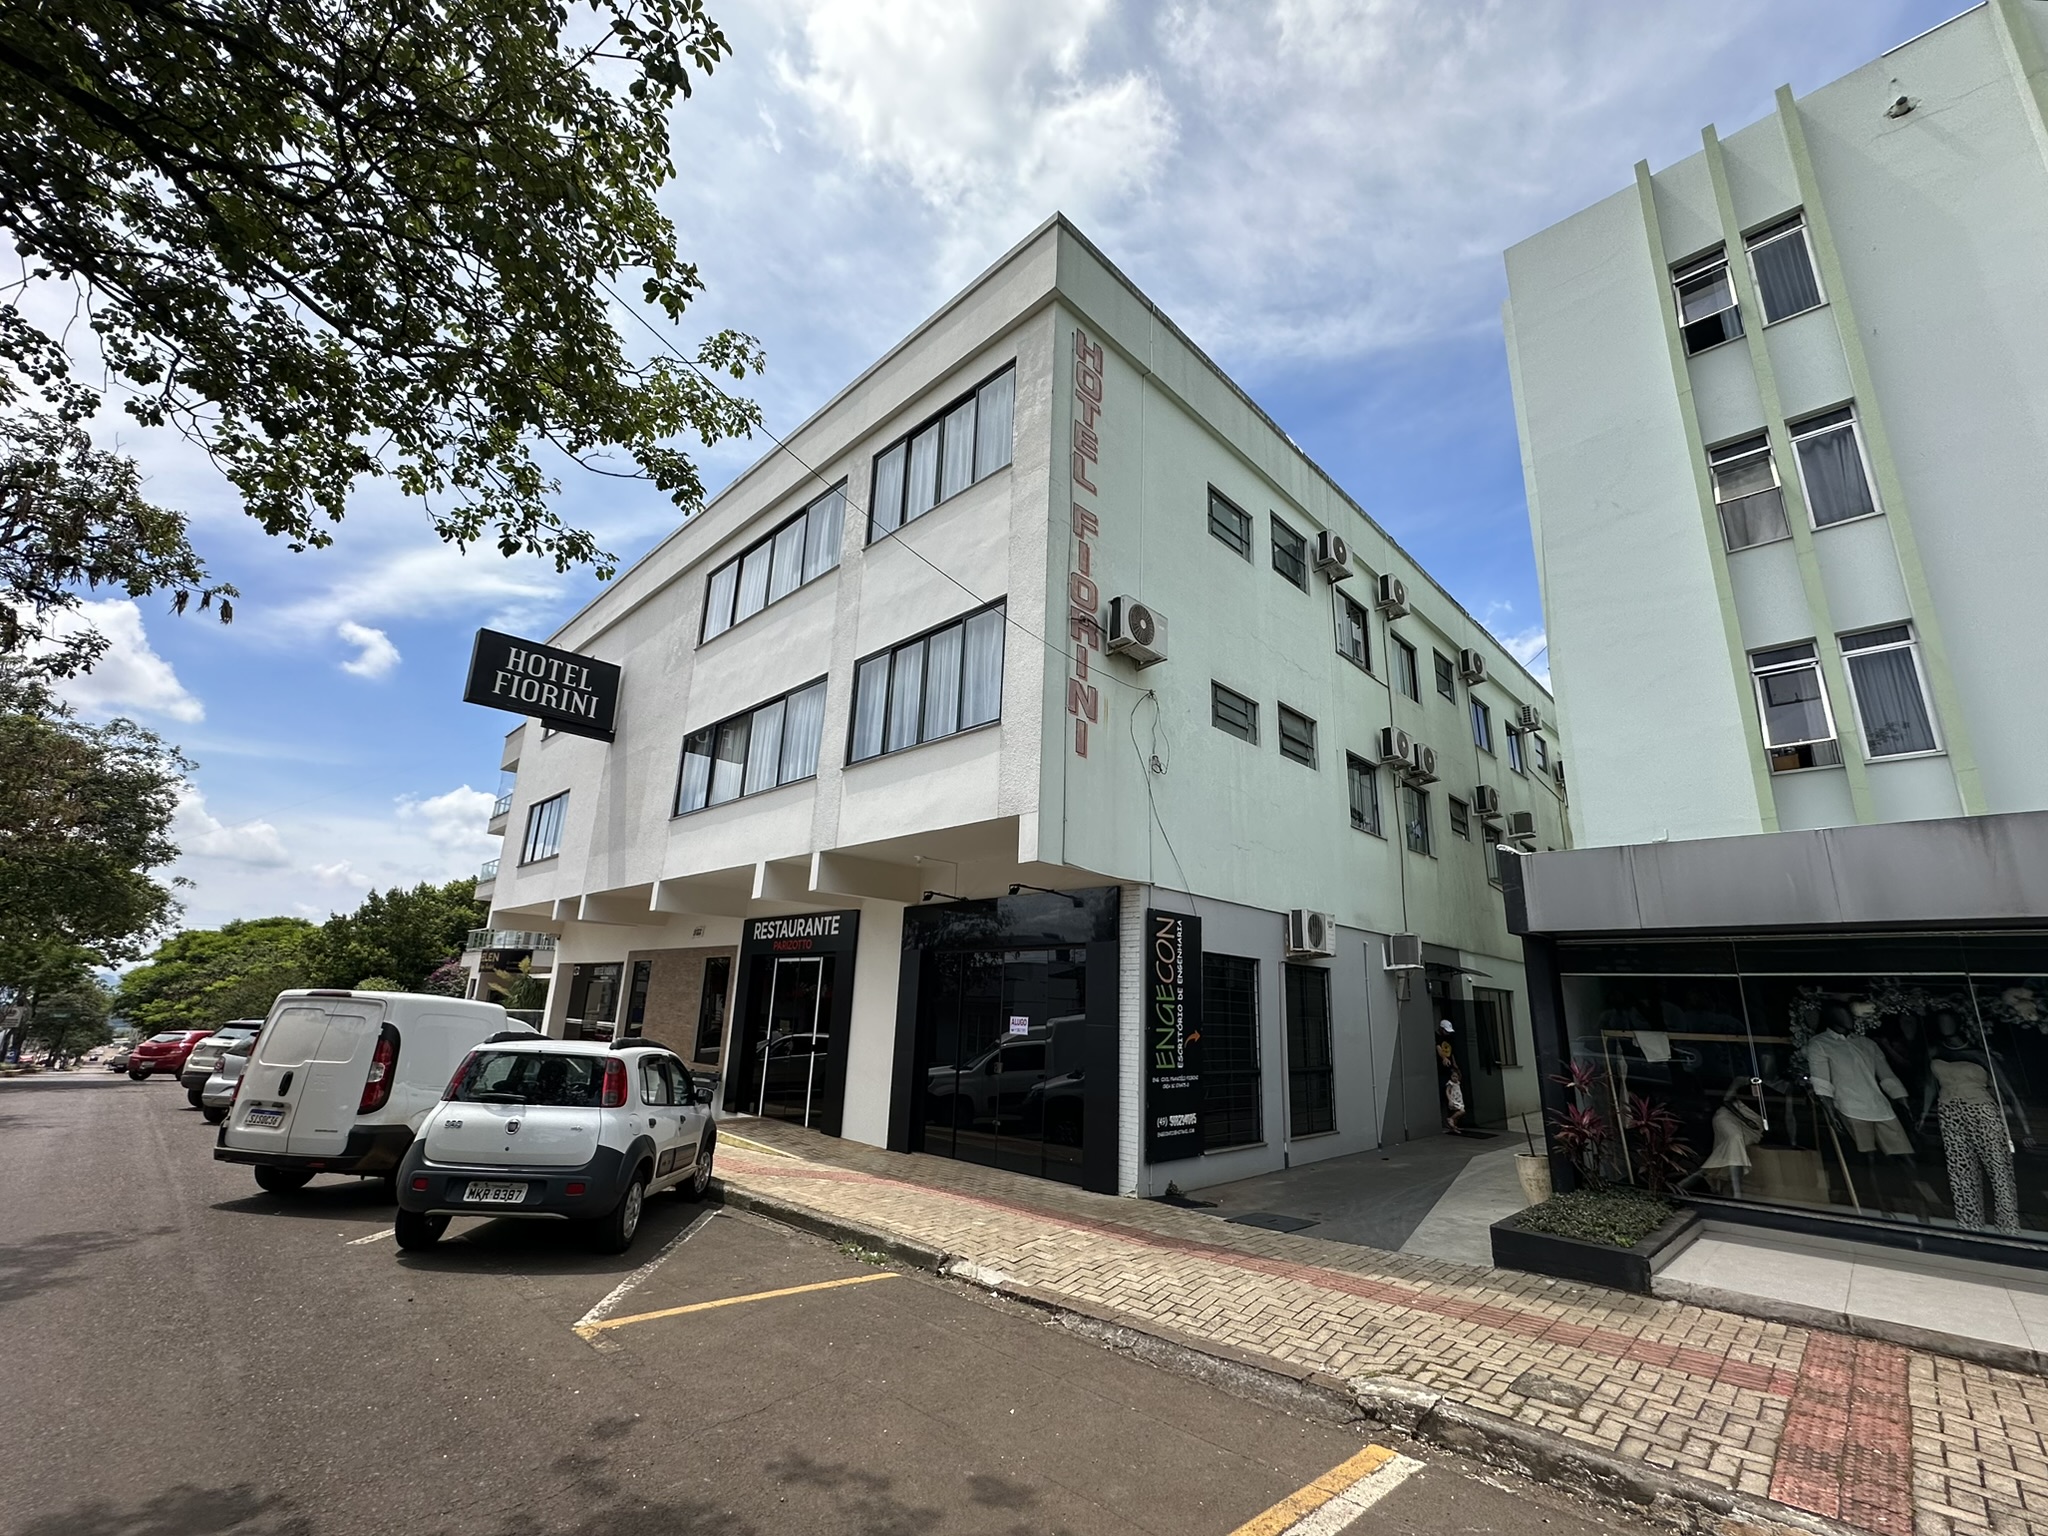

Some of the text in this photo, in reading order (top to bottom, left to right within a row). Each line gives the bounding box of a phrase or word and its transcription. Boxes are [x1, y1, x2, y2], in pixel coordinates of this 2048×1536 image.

[1067, 327, 1104, 760] HOTEL FIORINI
[491, 669, 600, 719] FIORINI
[505, 646, 593, 692] HOTEL
[753, 915, 841, 940] RESTAURANTE
[1155, 916, 1176, 1069] ENGECON
[1176, 919, 1184, 1069] ESCRITÓRIO DE ENGENHARIA
